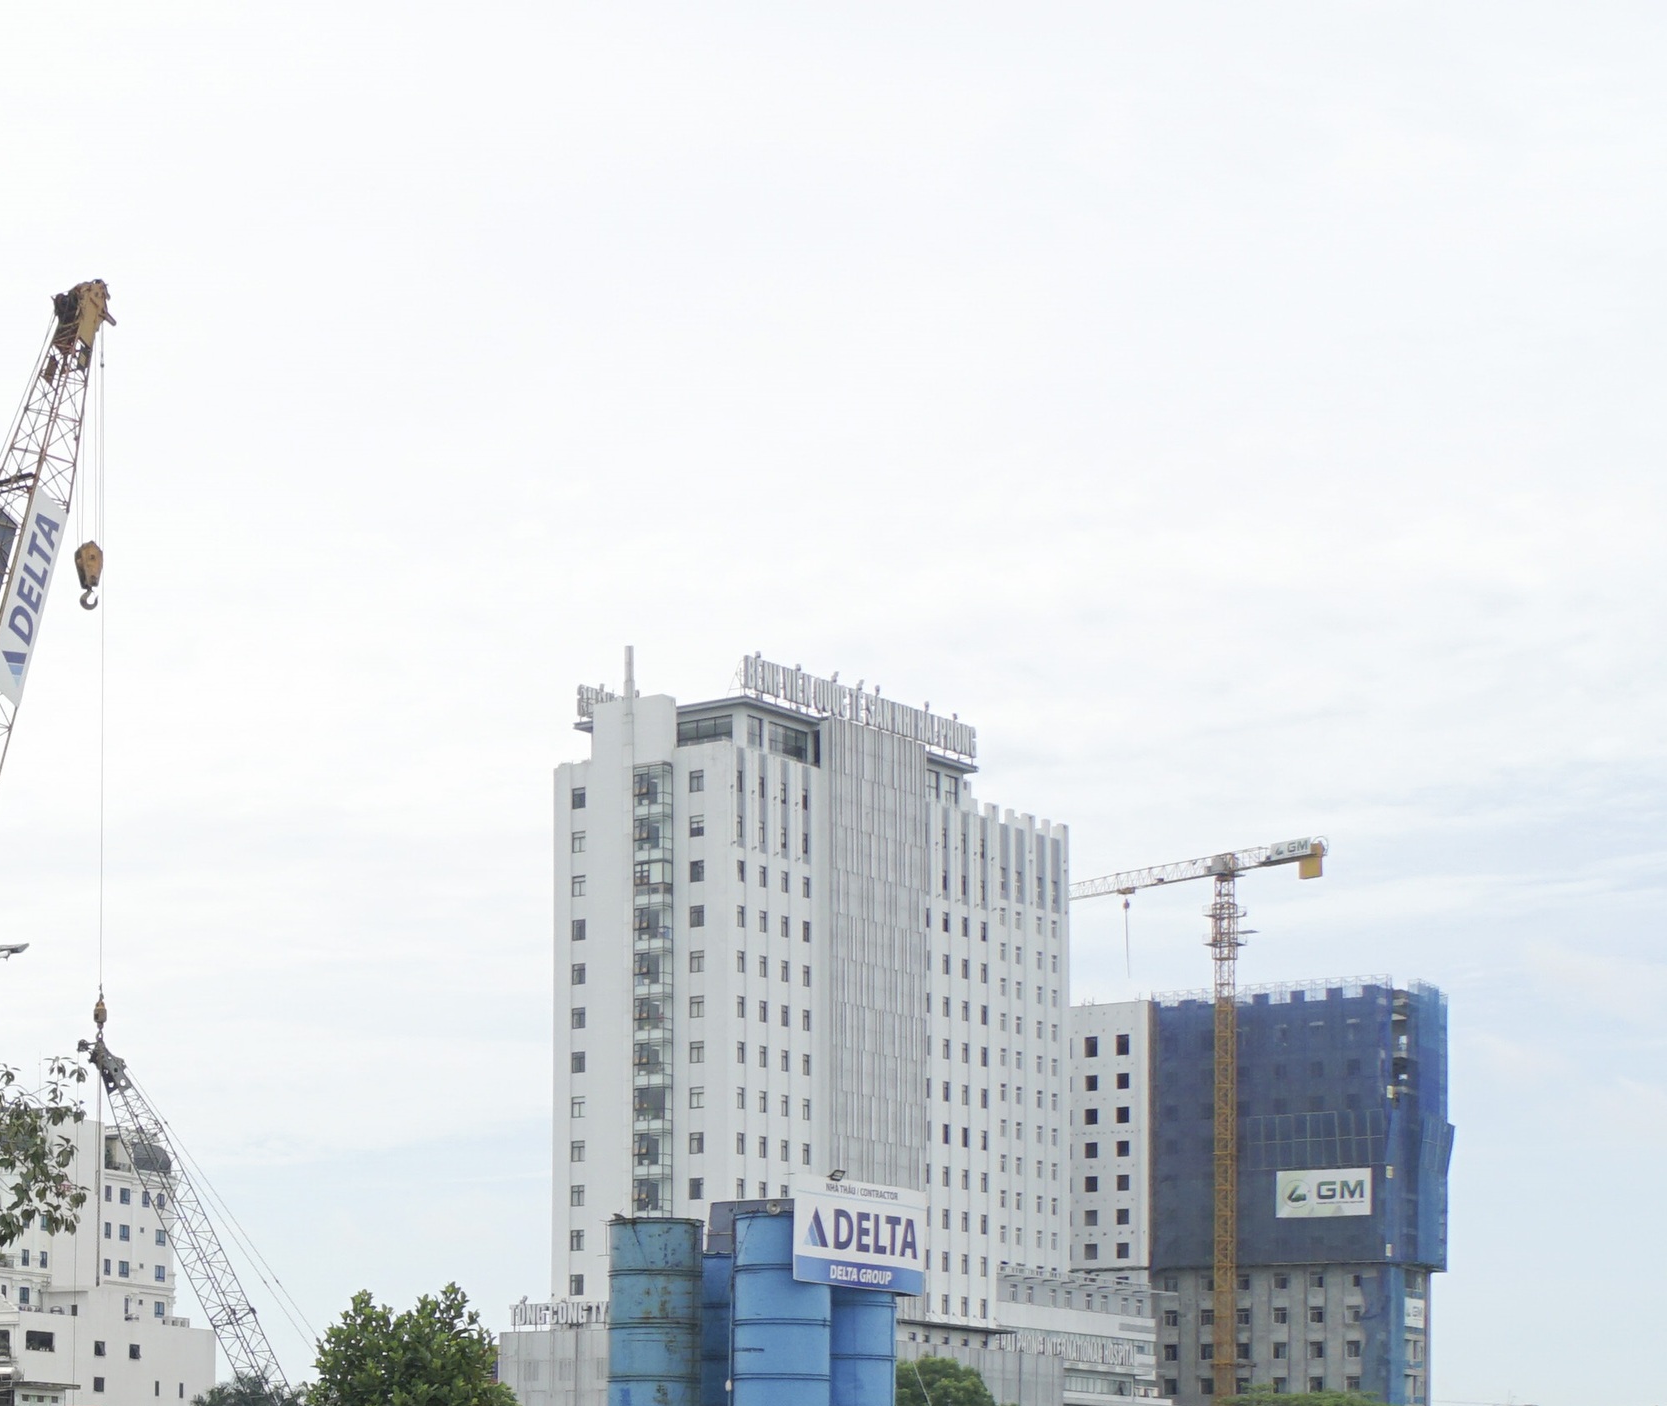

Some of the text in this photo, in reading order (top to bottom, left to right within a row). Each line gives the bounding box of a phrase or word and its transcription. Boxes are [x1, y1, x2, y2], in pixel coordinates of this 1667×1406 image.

[8, 512, 60, 647] DELTA
[860, 1189, 899, 1200] CONTRACTOR
[1316, 1180, 1365, 1200] GM
[832, 1208, 918, 1260] DELTA
[830, 1265, 893, 1285] DELTA GROUP
[509, 1295, 546, 1326] TỔNG
